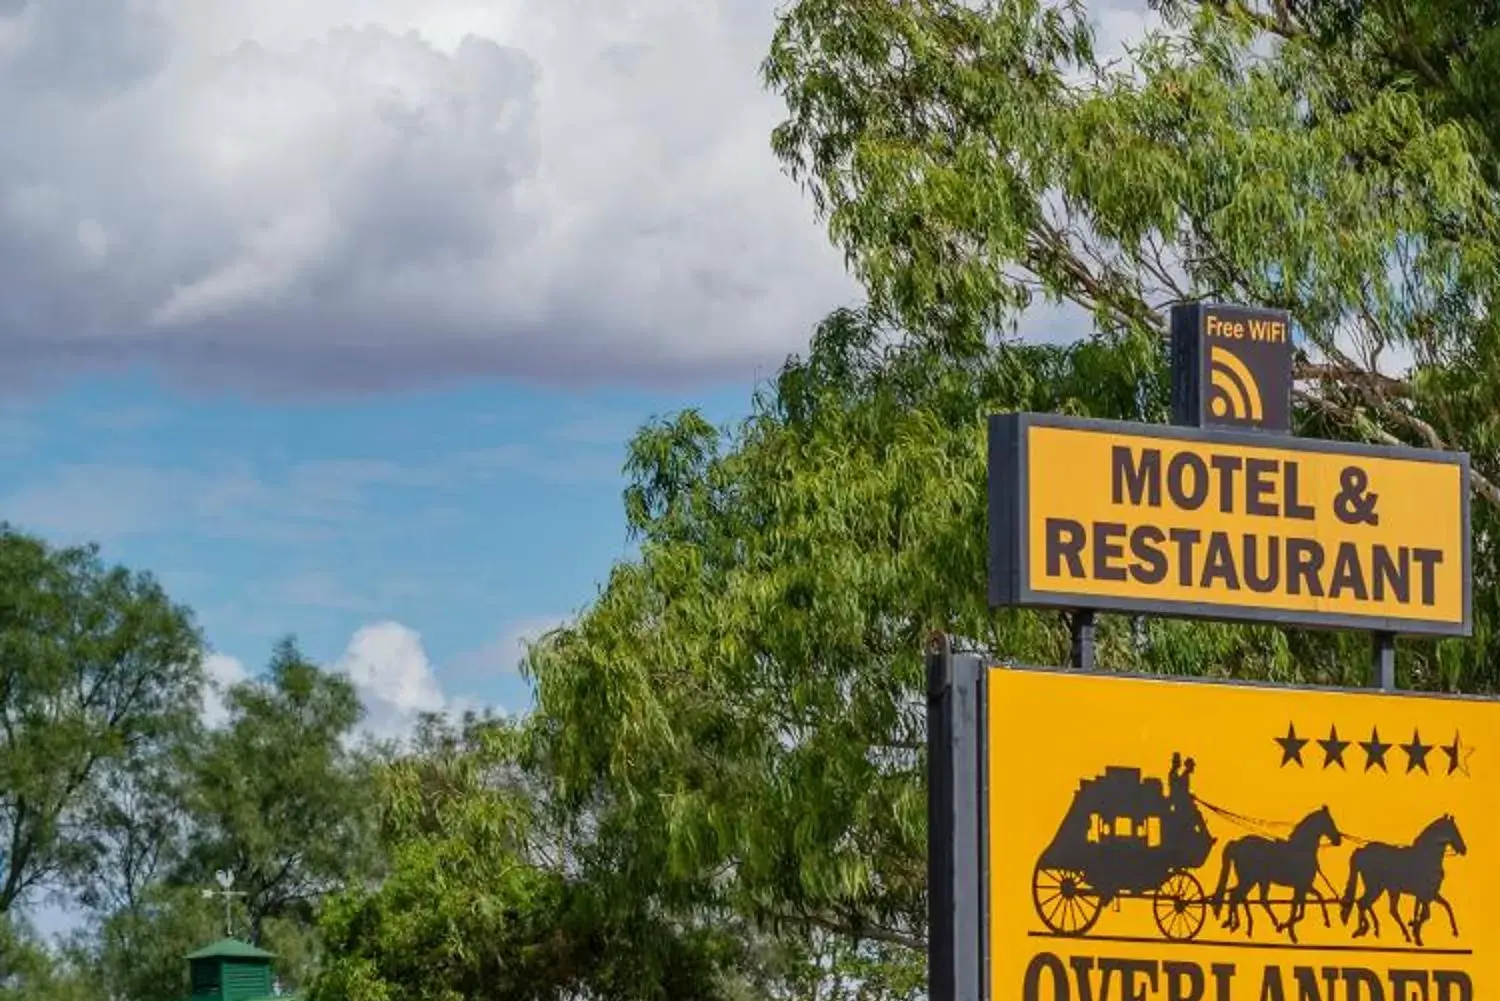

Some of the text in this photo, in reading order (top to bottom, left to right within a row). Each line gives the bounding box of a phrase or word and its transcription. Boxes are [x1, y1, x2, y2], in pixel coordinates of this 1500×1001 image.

[1207, 315, 1286, 344] Free WiFi
[1111, 445, 1380, 526] MOTEL &
[1045, 517, 1444, 607] RESTAURANT
